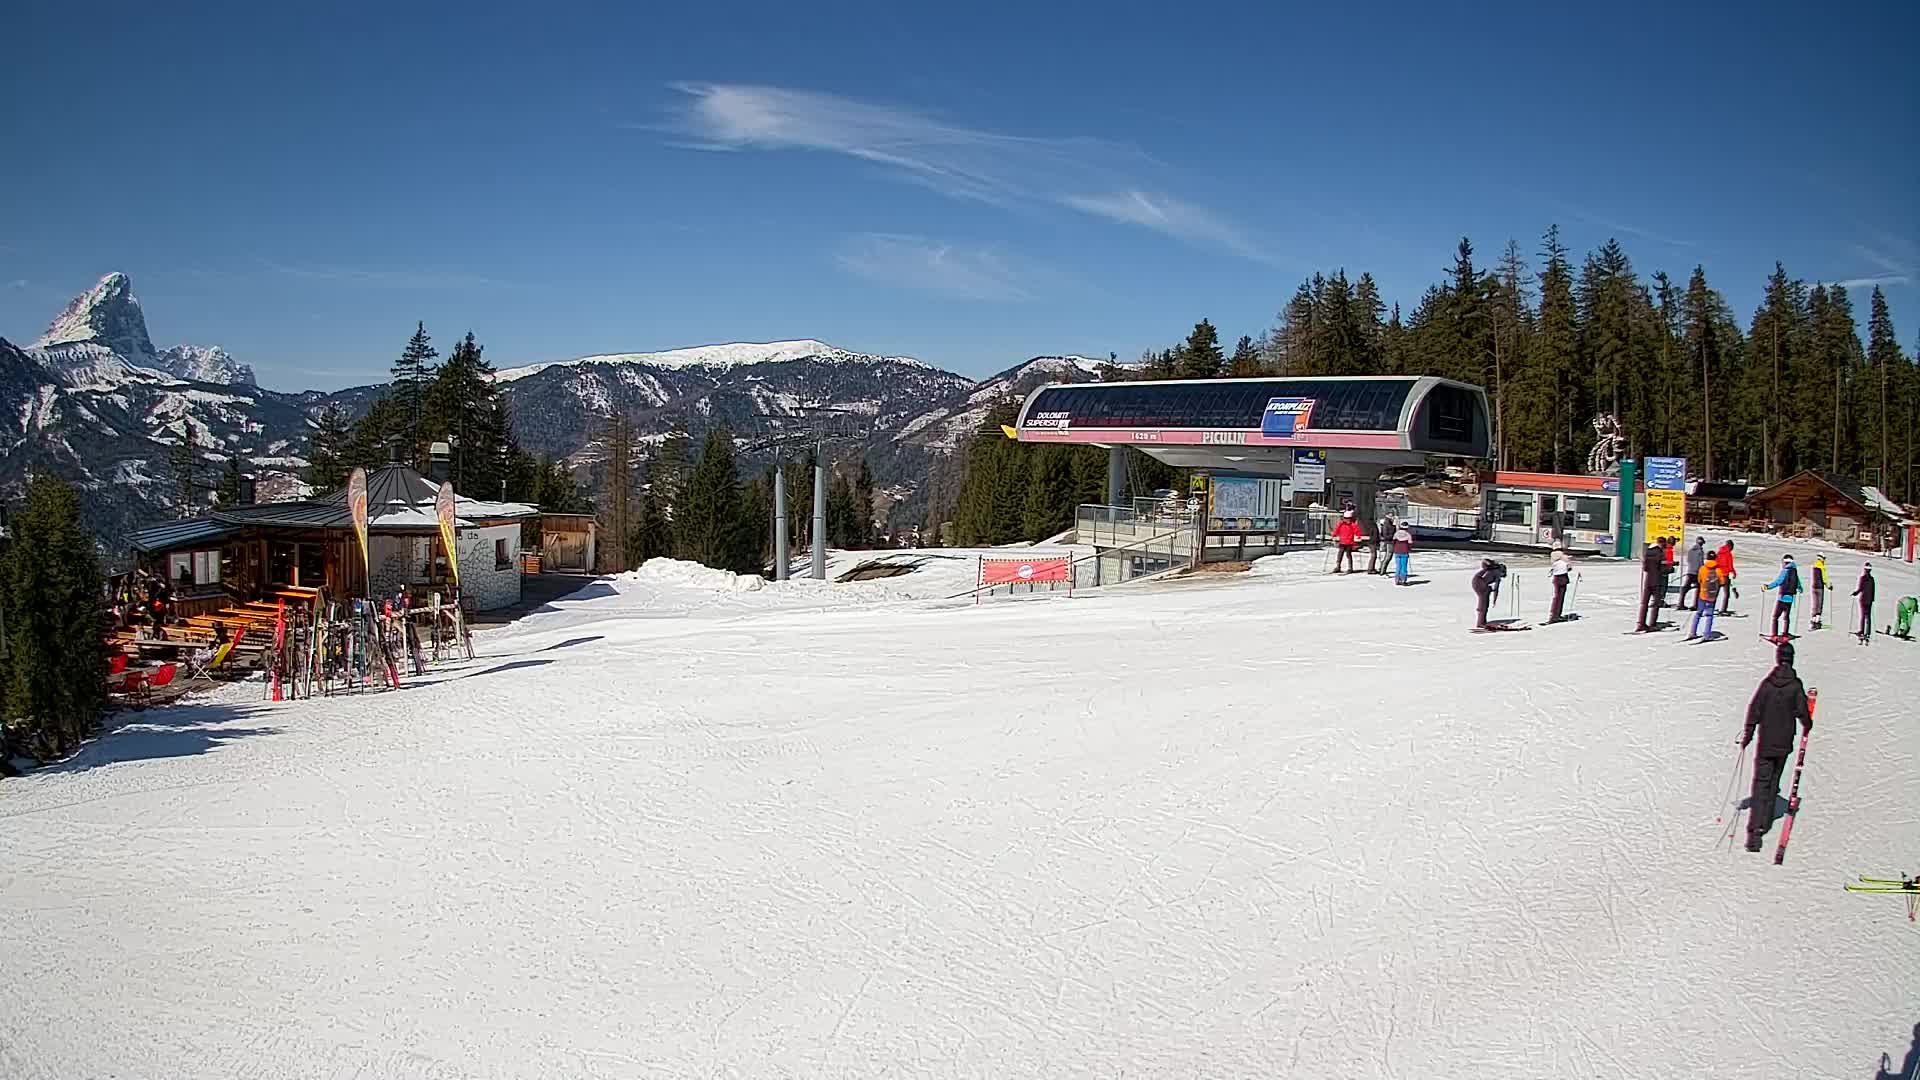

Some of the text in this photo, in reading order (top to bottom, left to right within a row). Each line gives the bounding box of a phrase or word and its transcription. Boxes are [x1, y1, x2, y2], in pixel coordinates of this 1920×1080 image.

[1266, 402, 1313, 411] KRONPLATZ
[1037, 411, 1070, 419] DOLOMITI
[1025, 419, 1059, 427] SUPERSKI
[1202, 431, 1246, 445] PICULIN
